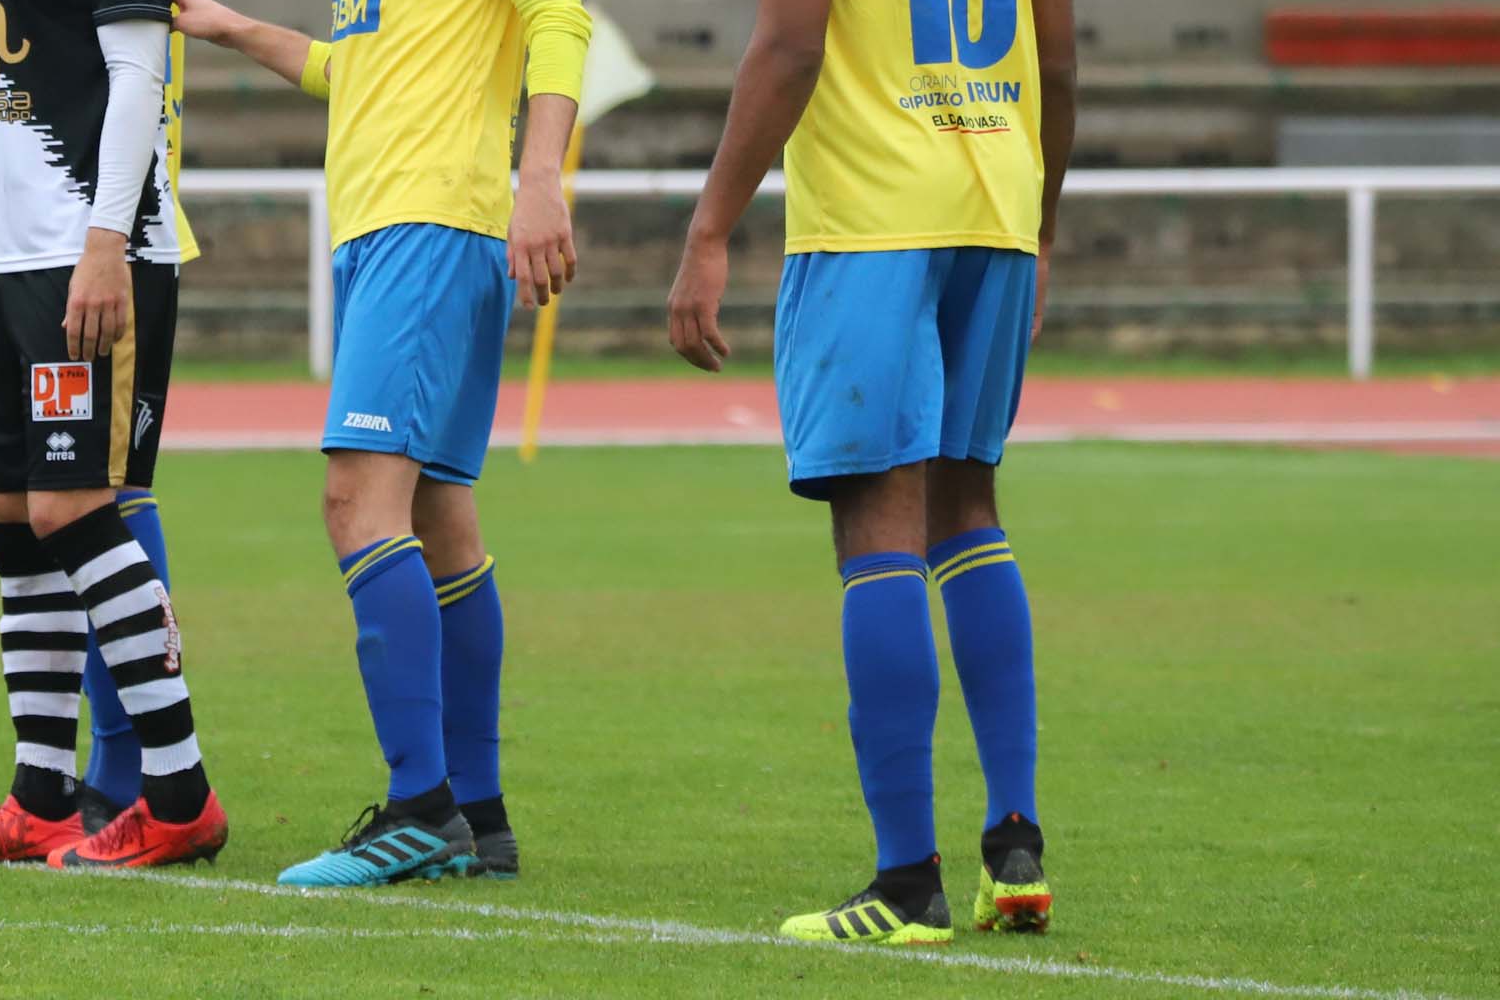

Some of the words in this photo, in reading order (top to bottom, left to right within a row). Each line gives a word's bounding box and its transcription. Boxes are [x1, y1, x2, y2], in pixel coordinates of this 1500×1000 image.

[966, 81, 1021, 103] IRUN
[931, 114, 948, 128] EL
[342, 411, 393, 433] ZEBRA
